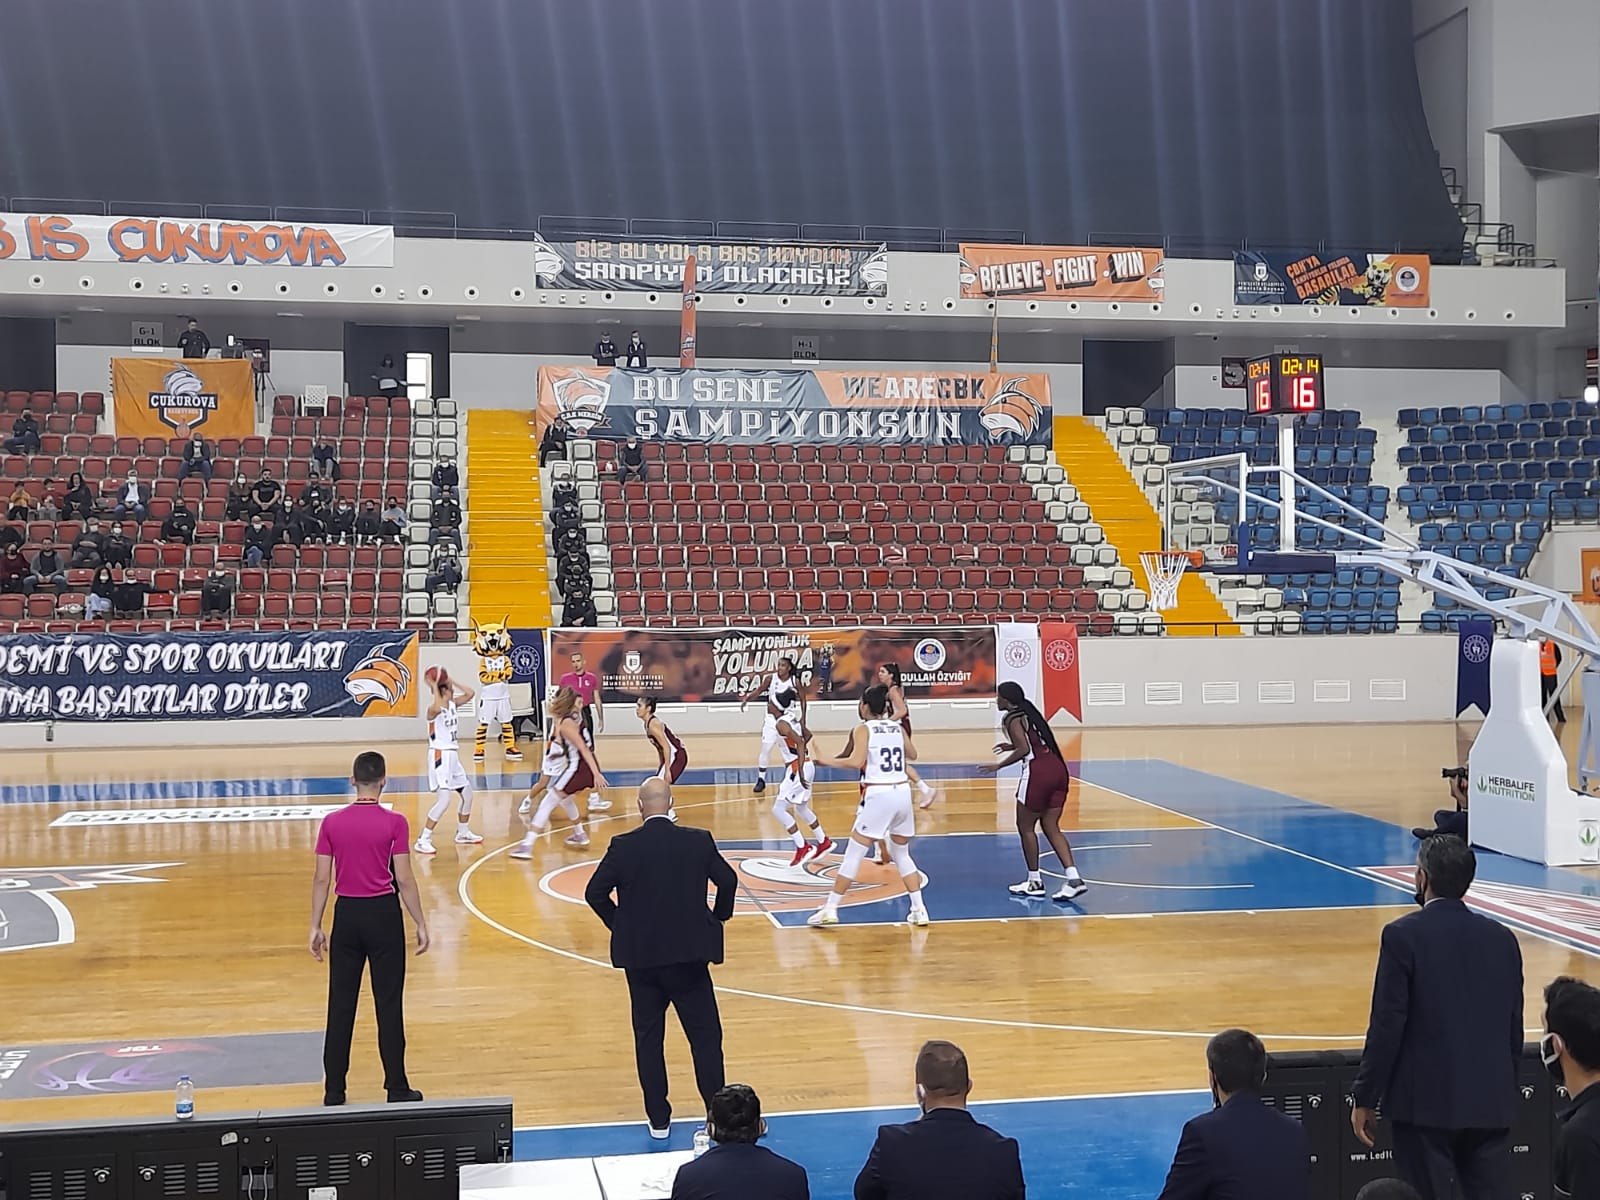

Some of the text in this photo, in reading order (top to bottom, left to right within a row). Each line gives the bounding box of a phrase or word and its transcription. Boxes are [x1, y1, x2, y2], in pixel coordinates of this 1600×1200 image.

[26, 216, 89, 260] IS
[620, 242, 648, 259] BU
[979, 251, 1146, 292] BELIEVE FIGHT WIN
[133, 337, 161, 346] BLOK
[139, 327, 155, 335] G-1
[793, 351, 817, 359] BLOK
[1281, 358, 1319, 375] 02:14
[1248, 360, 1270, 379] 02:14
[632, 376, 681, 400] BU
[693, 377, 783, 402] SENE
[1255, 380, 1270, 413] 16
[1292, 377, 1315, 408] 16
[635, 408, 962, 440] ŞAMPİYONSUN
[75, 643, 122, 675] VE
[124, 642, 202, 673] SPOR
[223, 676, 311, 713] DİLER
[880, 746, 903, 772] 33
[1488, 775, 1536, 793] HERBALIFE
[1488, 785, 1536, 802] NUTRITION
